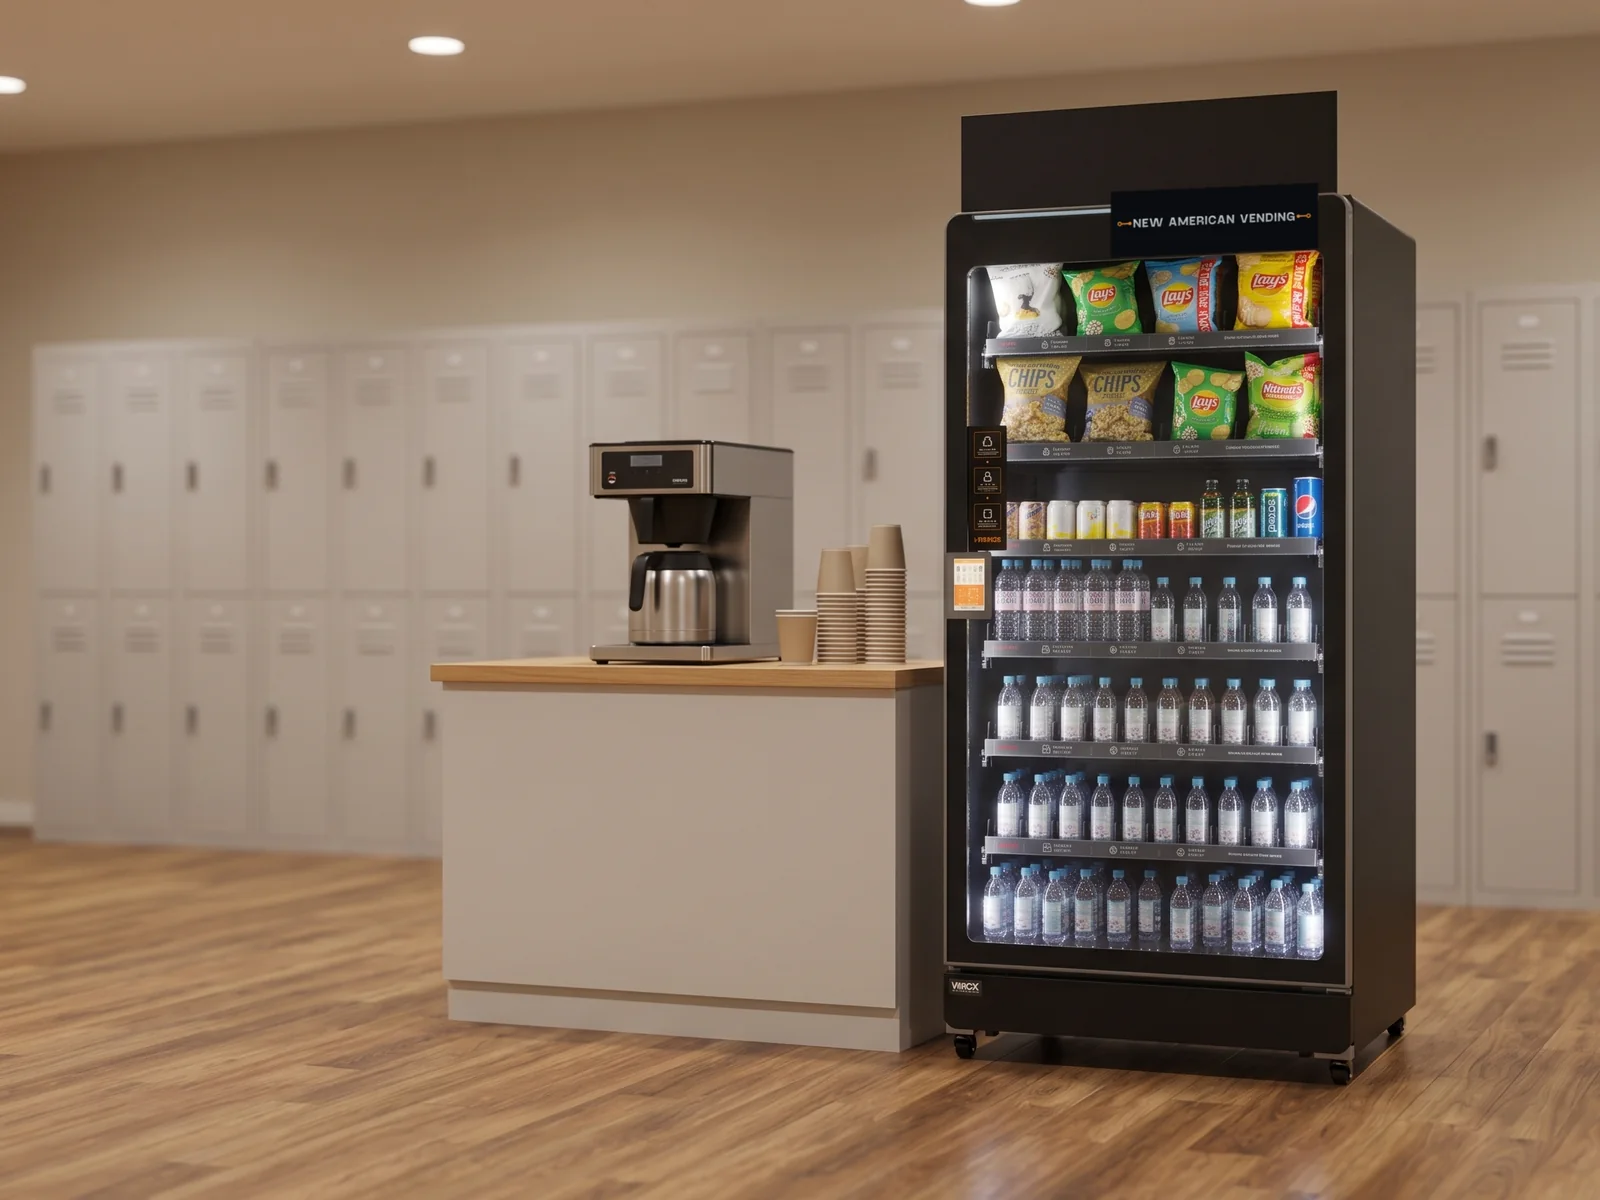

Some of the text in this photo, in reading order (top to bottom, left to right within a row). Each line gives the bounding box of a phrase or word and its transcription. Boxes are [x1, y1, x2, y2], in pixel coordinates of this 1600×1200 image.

[1132, 211, 1296, 229] NEW AMERICAN VENDING
[1008, 368, 1056, 389] CHIPS
[1093, 374, 1142, 393] CHIPS
